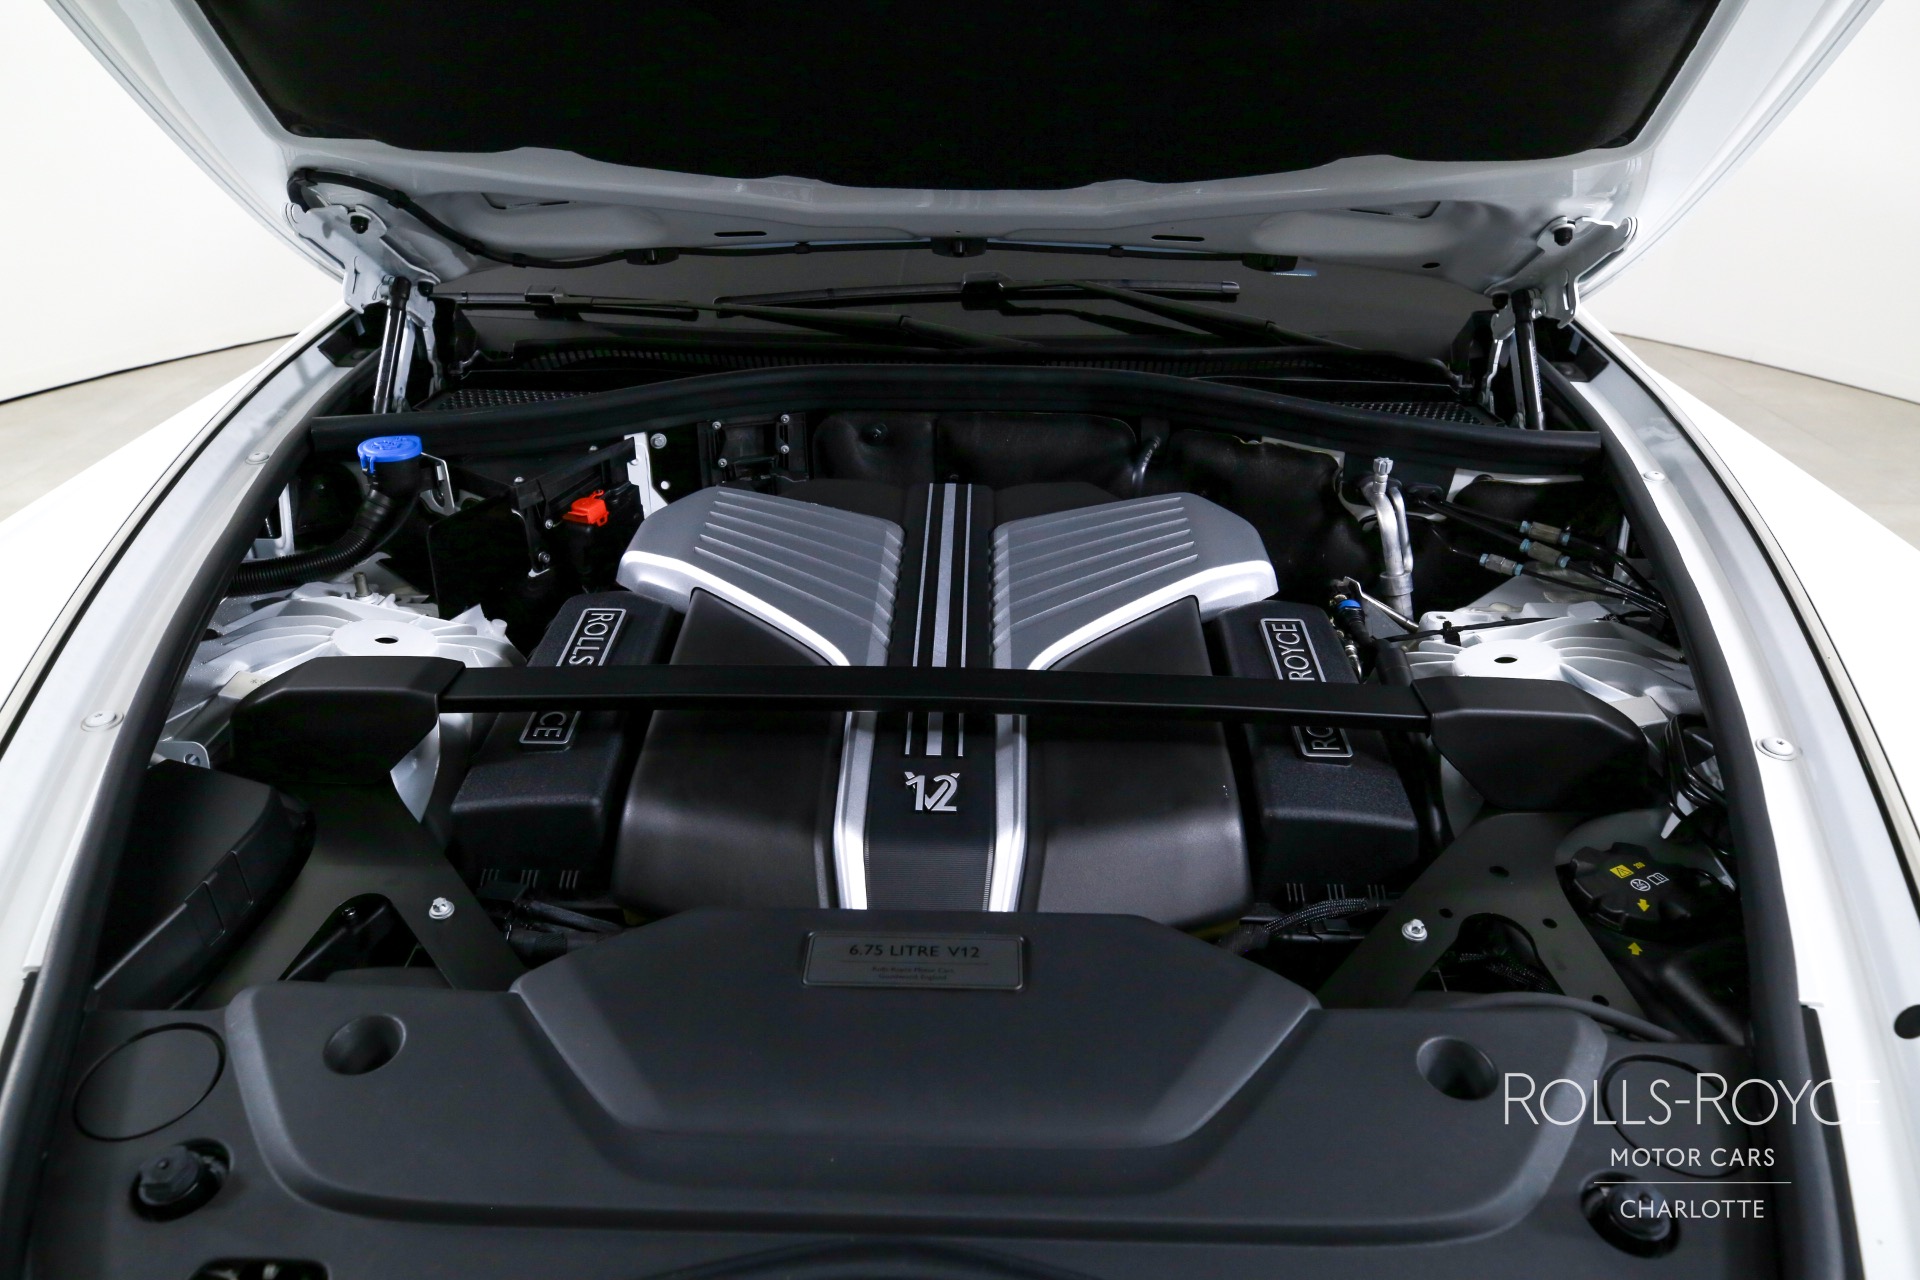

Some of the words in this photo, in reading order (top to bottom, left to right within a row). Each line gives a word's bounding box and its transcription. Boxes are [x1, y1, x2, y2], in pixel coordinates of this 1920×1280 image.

[568, 612, 616, 666] ROLLS
[1271, 623, 1316, 682] ROYCE
[849, 944, 883, 957] 6.75
[890, 944, 939, 958] LITRE
[947, 945, 980, 958] V12
